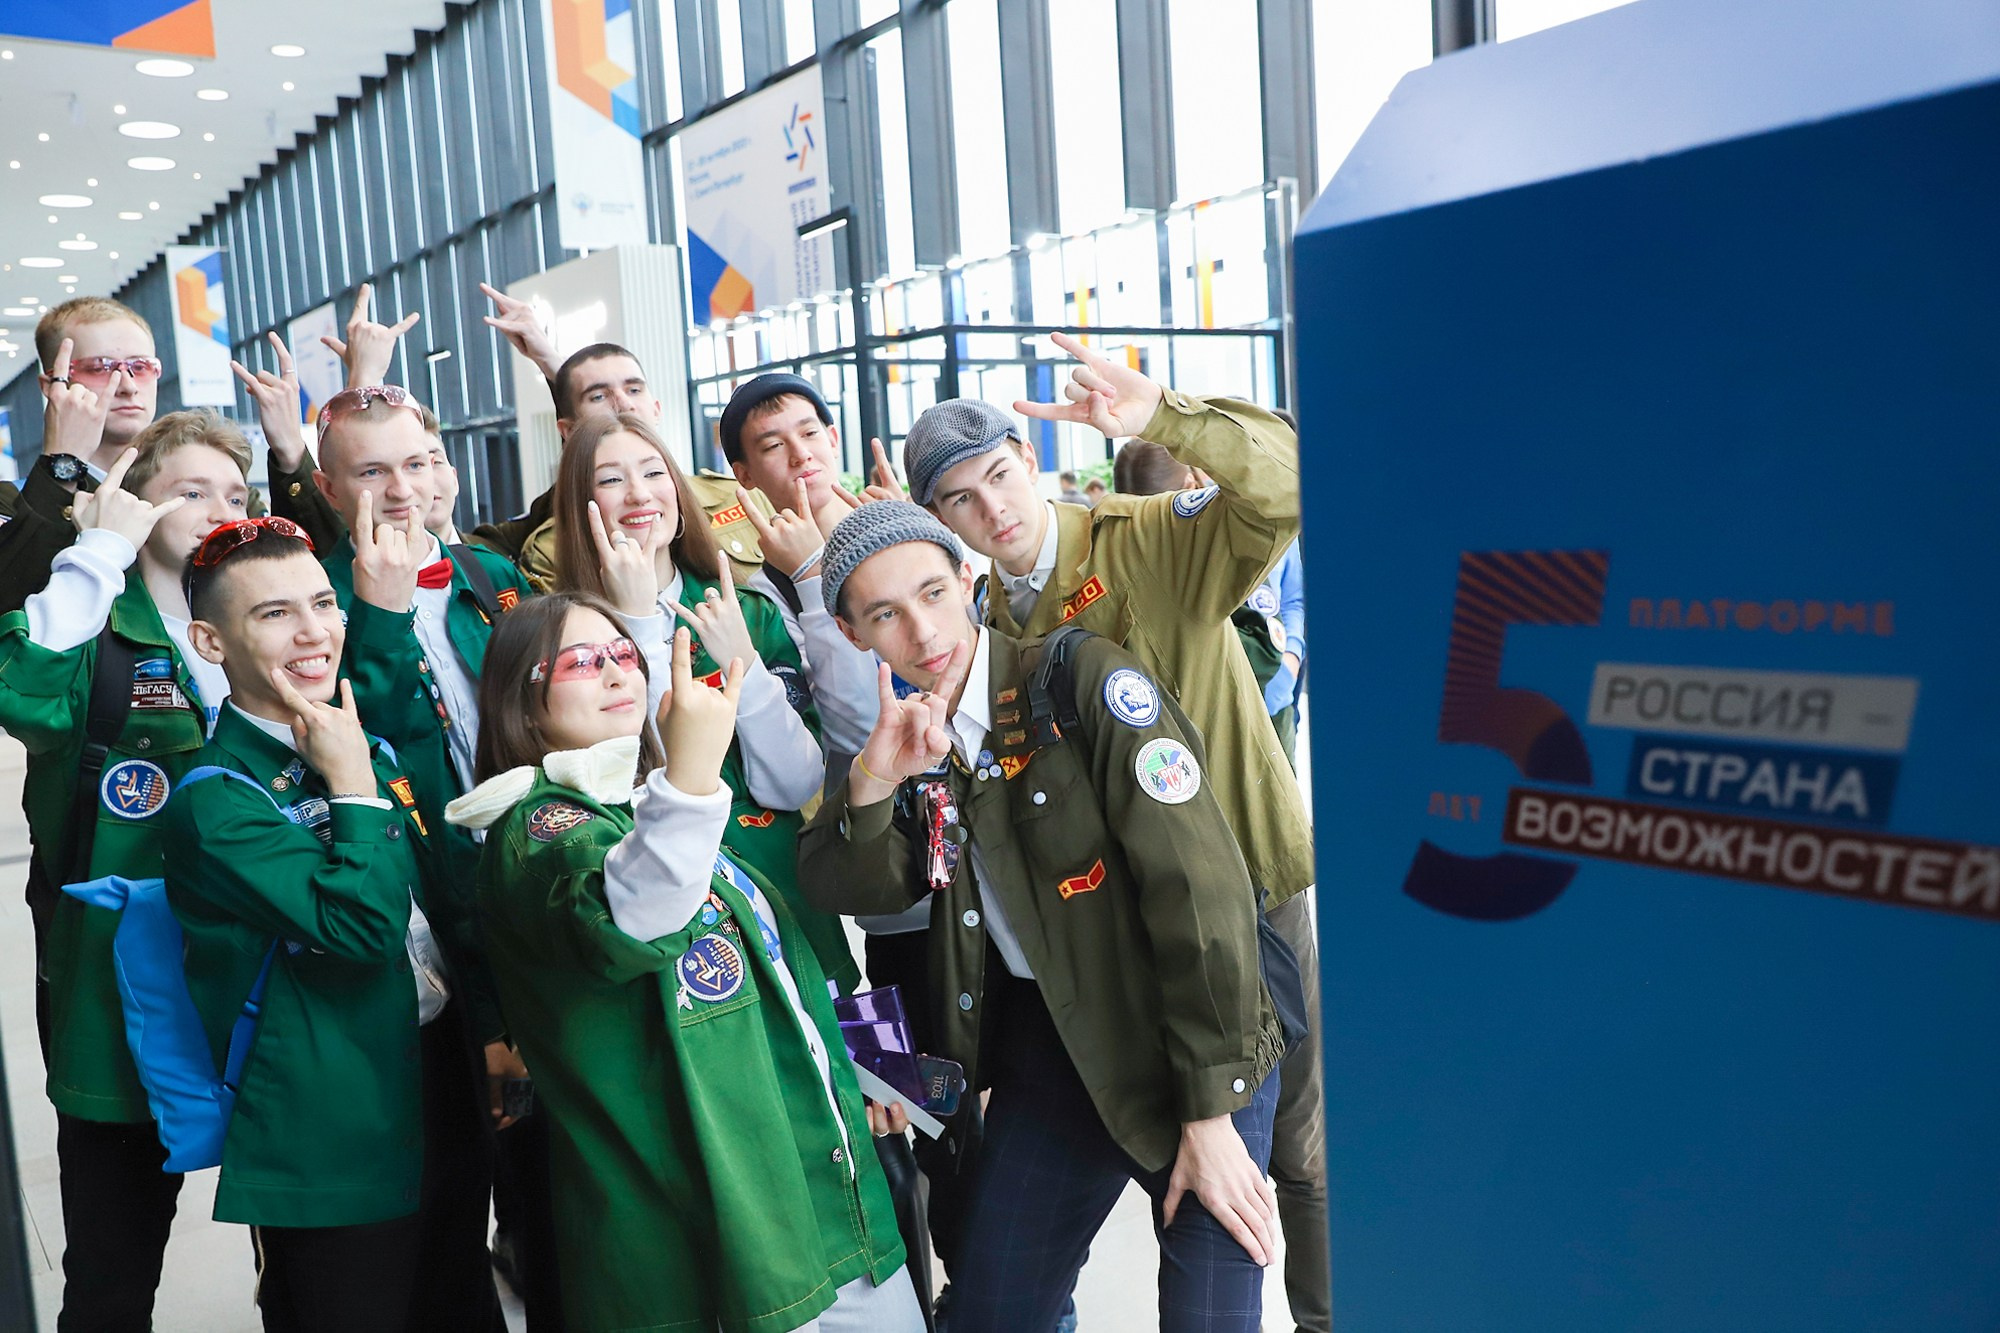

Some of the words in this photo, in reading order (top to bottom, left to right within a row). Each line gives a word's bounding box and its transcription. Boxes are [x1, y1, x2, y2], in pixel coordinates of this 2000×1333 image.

[1629, 597, 1895, 636] ПЛАТФОРМЕ
[1603, 675, 1835, 732] РОССИЯ
[1427, 792, 1482, 823] ЛЕТ
[1640, 747, 1868, 817] СТРАНА
[1514, 796, 2000, 911] ВОЗМОЖНОСТЕЙ
